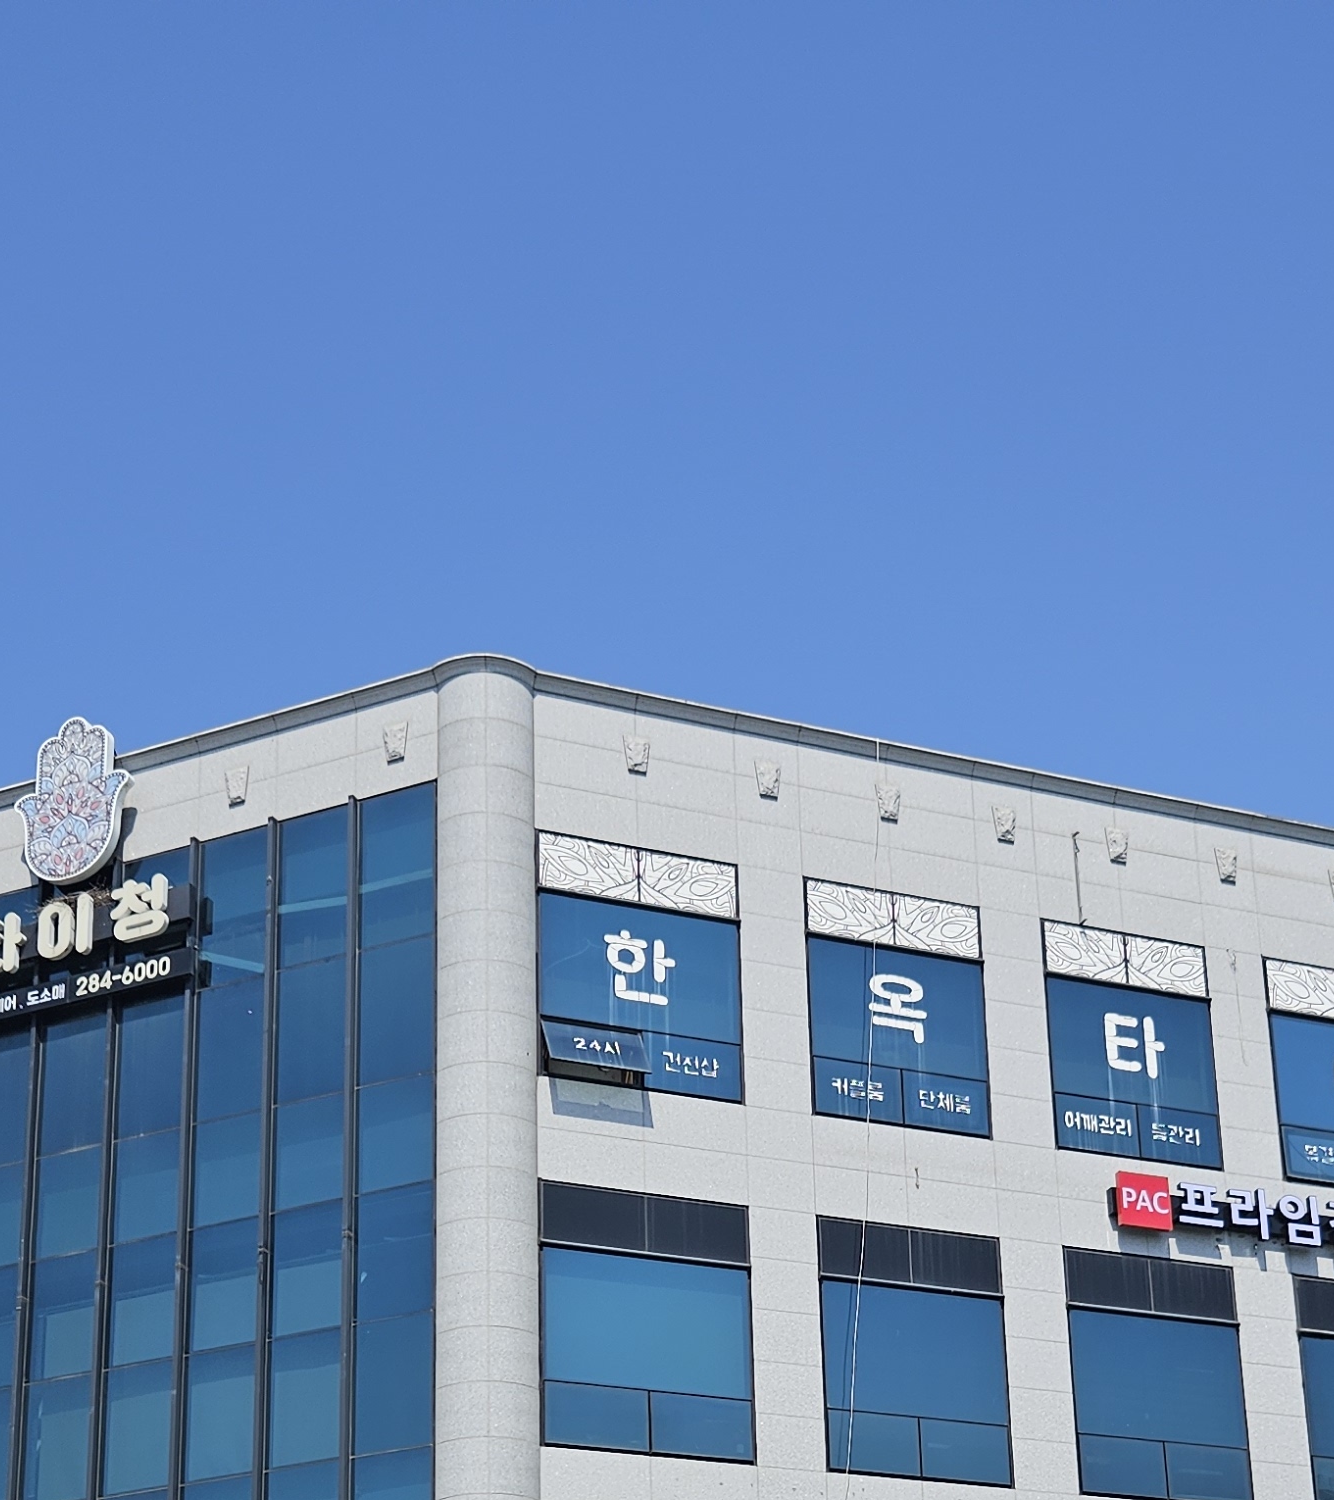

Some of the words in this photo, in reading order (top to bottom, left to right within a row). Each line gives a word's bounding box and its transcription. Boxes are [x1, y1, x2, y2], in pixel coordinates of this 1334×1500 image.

[27, 983, 66, 1007] 도소매
[76, 956, 171, 996] 284-6000
[603, 929, 676, 1006] 한
[868, 973, 927, 1044] 옥
[1103, 1012, 1165, 1079] 타
[573, 1037, 622, 1055] 24시
[1064, 1111, 1132, 1137] 어깨관리
[1120, 1185, 1170, 1216] PAC
